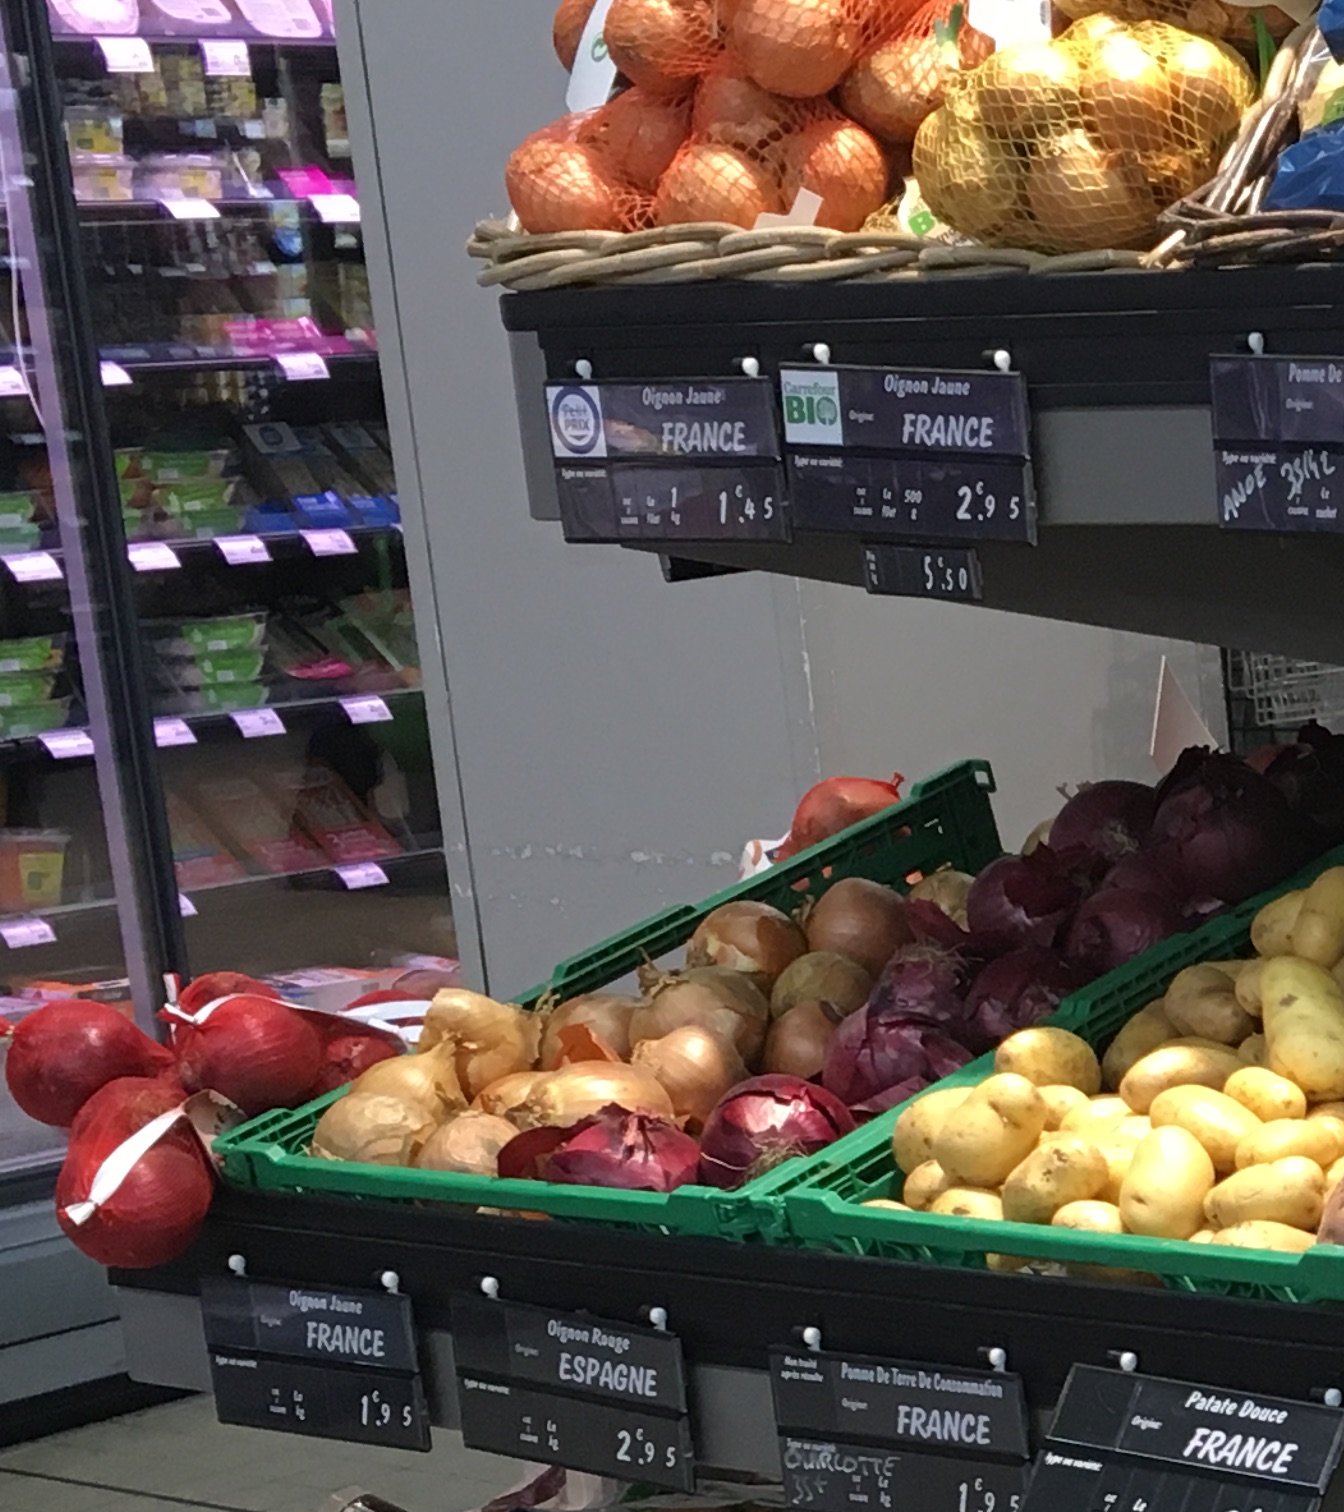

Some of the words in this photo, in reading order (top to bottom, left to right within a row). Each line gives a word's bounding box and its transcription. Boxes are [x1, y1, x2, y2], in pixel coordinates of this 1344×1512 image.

[784, 381, 836, 396] Carrefour
[884, 374, 928, 398] Oignon
[930, 377, 971, 396] Jaune
[1289, 363, 1325, 384] Pomme
[1328, 363, 1342, 382] De
[642, 387, 682, 410] Oignon
[686, 386, 721, 405] Jaune
[785, 396, 838, 426] BIO
[564, 418, 590, 431] PRIX
[662, 421, 746, 452] FRANCE
[902, 413, 994, 448] FRANCE
[904, 490, 922, 504] 500
[290, 1290, 326, 1312] Oignon
[330, 1295, 362, 1315] Jaune
[307, 1322, 385, 1357] FRANCE
[548, 1320, 588, 1343] Oignon
[592, 1327, 630, 1353] Rouge
[559, 1353, 657, 1397] ESPAGNE
[841, 1363, 874, 1382] Pomme
[877, 1365, 889, 1383] De
[892, 1368, 916, 1388] Terre
[919, 1371, 931, 1390] De
[934, 1374, 1002, 1398] Consommation
[1185, 1391, 1237, 1416] Patate
[1238, 1400, 1288, 1424] Douce
[897, 1405, 990, 1445] FRANCE
[1183, 1428, 1299, 1474] FRANCE
[1132, 1499, 1147, 1512] Le
